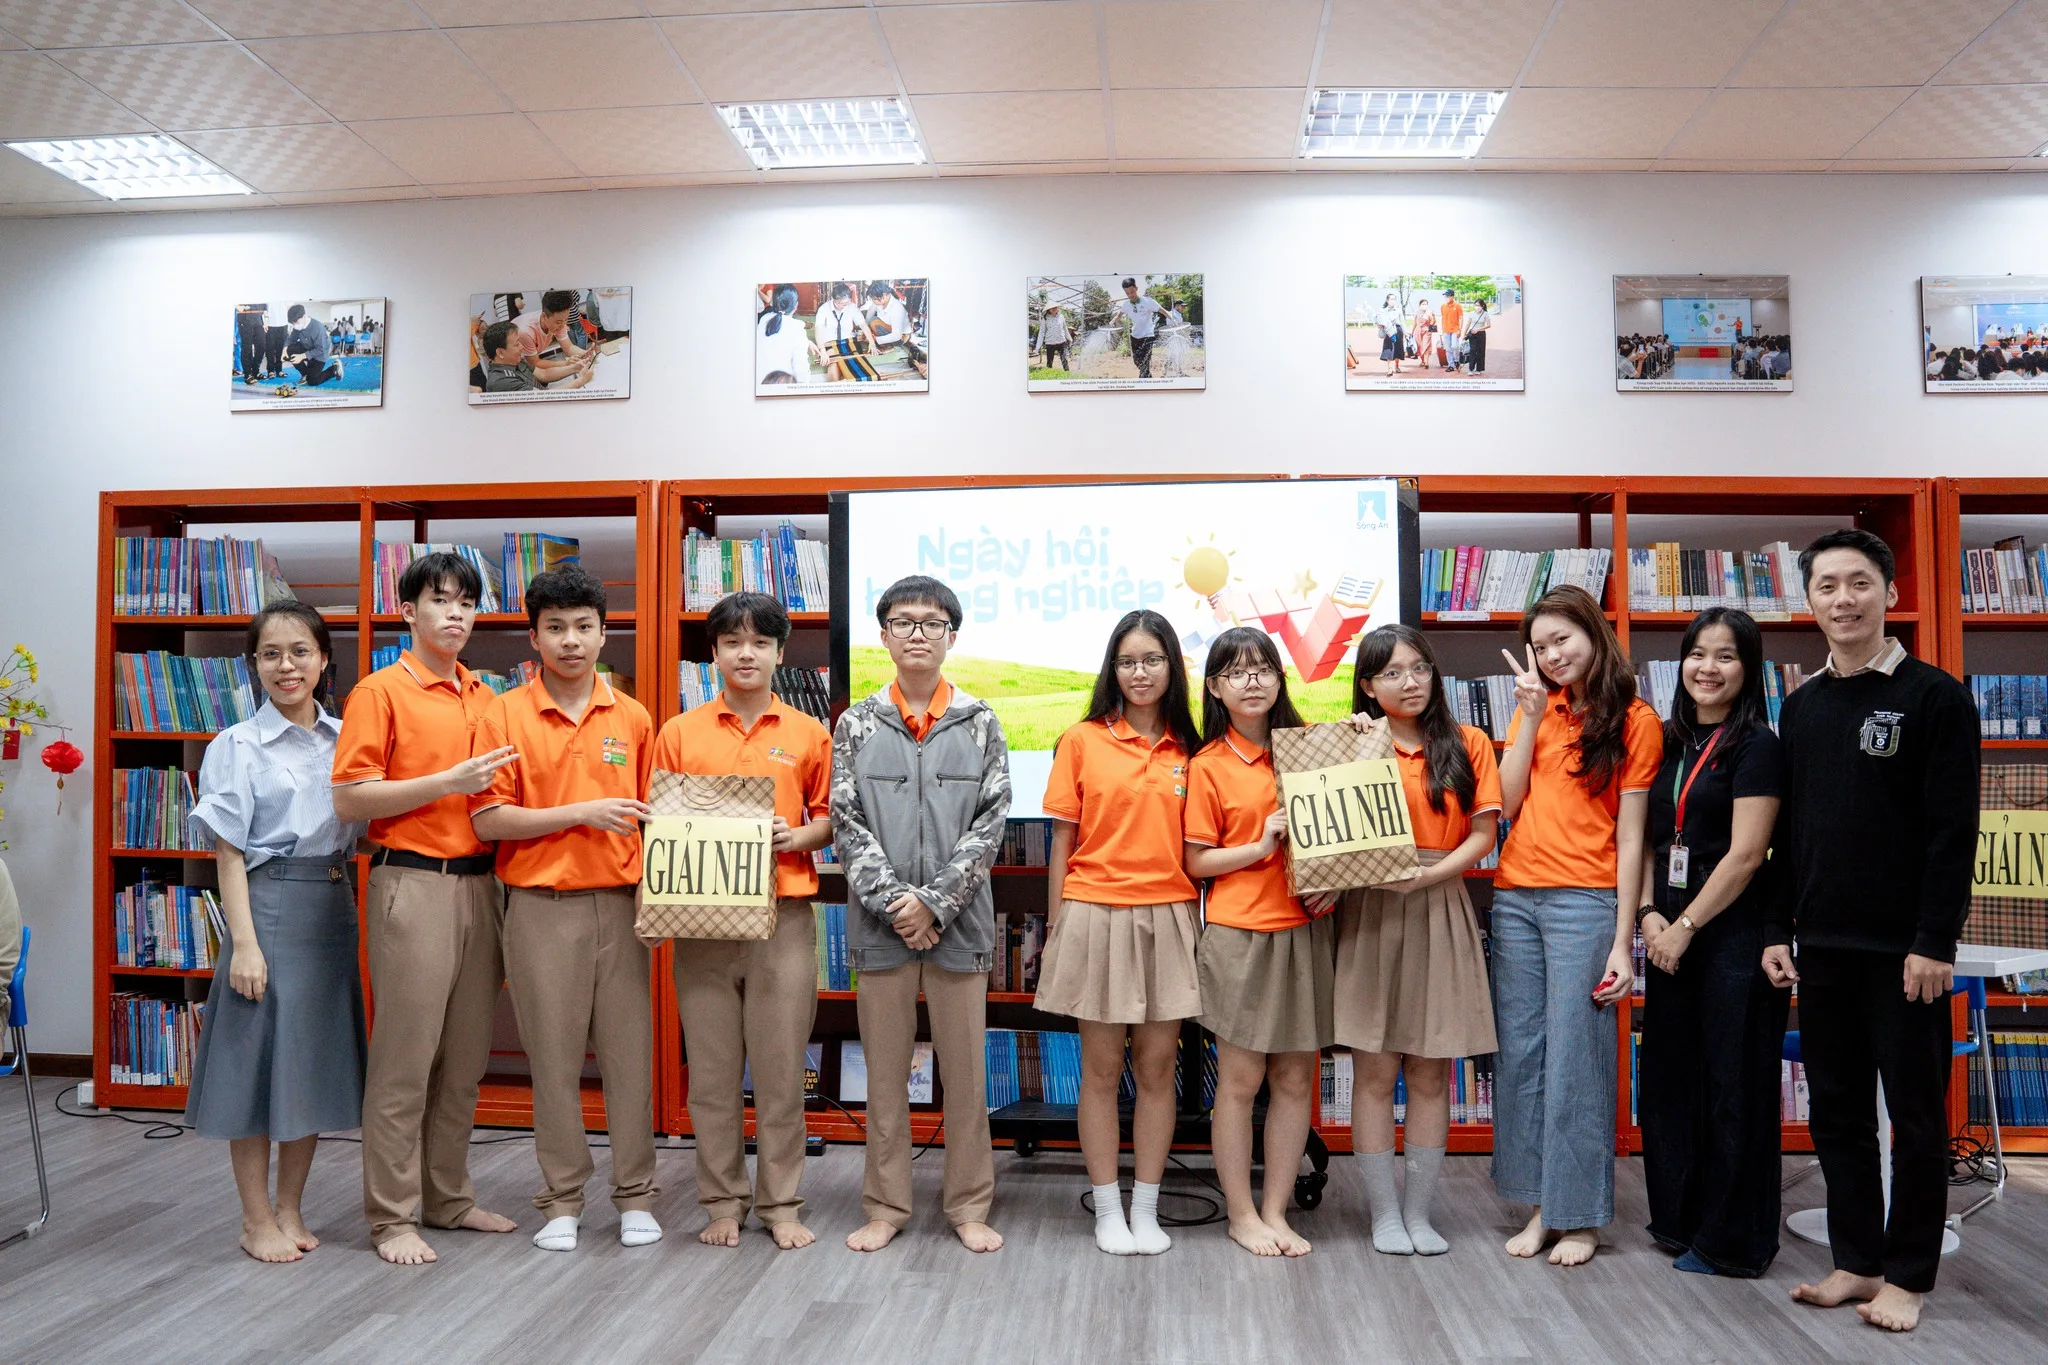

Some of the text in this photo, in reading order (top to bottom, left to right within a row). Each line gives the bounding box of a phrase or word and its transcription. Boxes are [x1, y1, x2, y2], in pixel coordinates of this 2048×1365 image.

[917, 525, 1031, 580] Ngày
[1290, 764, 1408, 849] GIẢI NHÌ
[646, 821, 766, 896] GIẢI NHÌ
[1973, 814, 2022, 886] GIẢI
